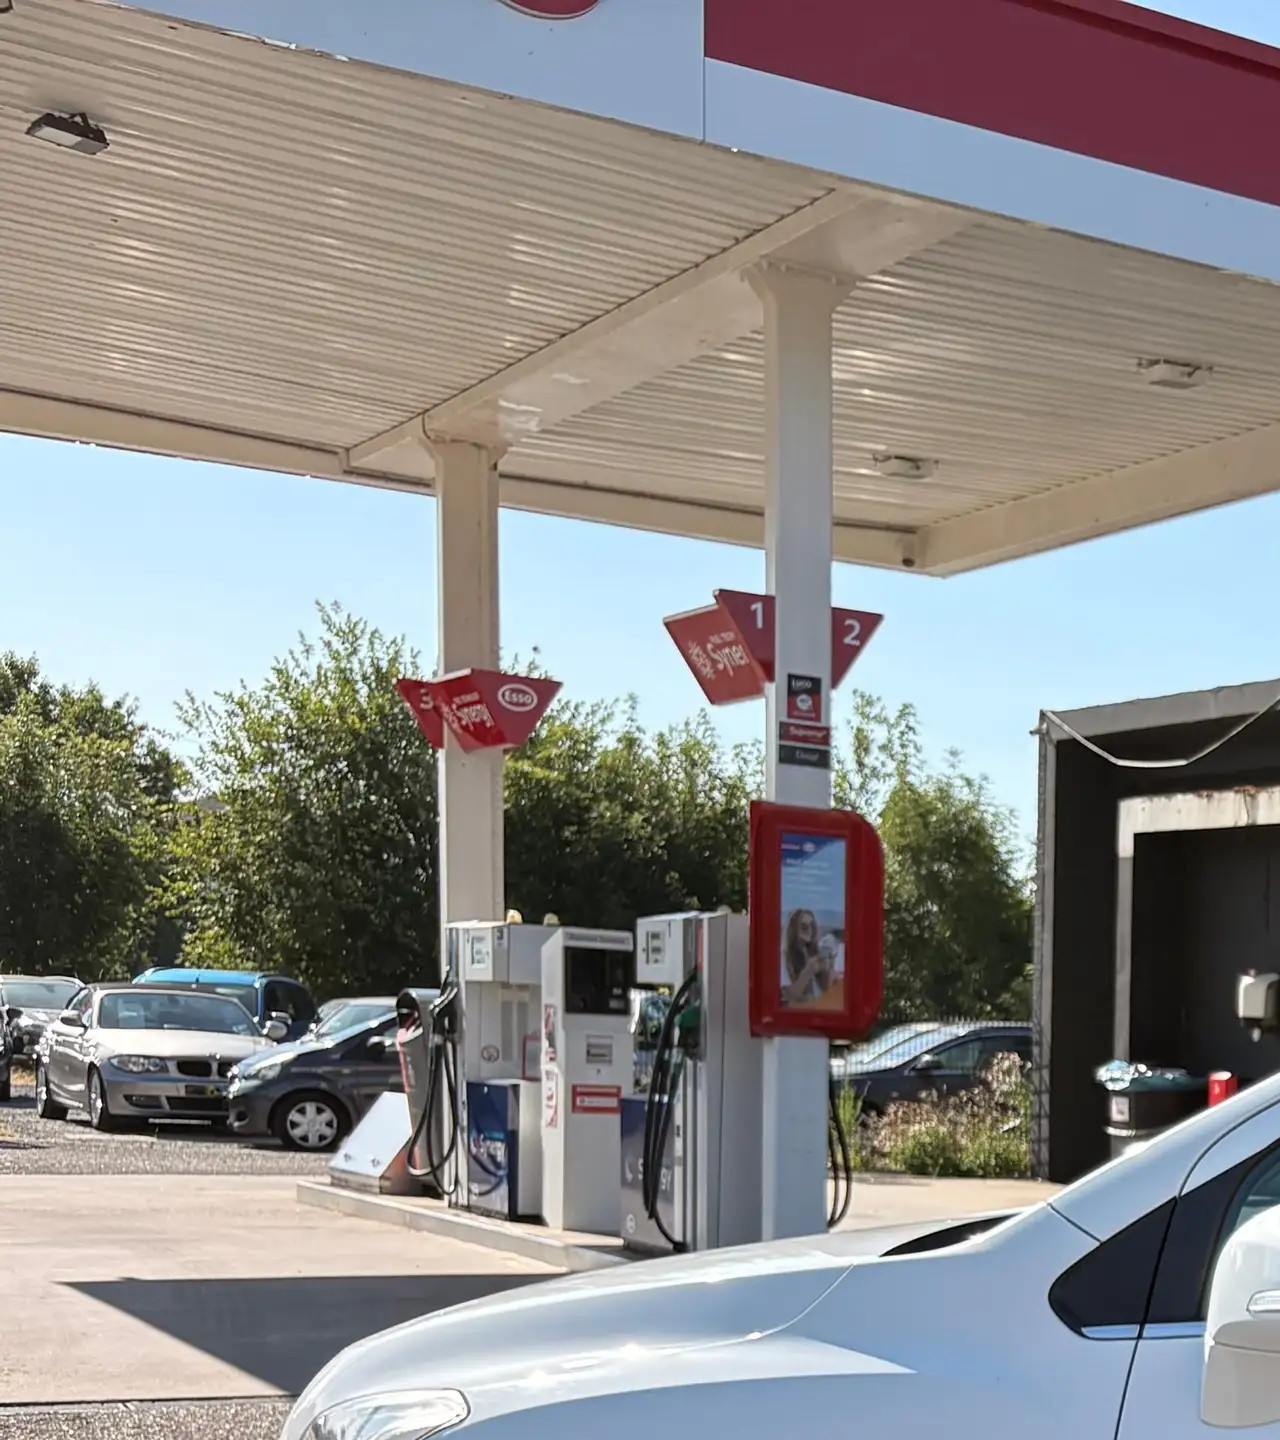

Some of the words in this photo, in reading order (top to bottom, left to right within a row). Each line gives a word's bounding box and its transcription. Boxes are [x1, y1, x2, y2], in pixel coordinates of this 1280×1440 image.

[750, 601, 764, 629] 1
[843, 619, 861, 647] 2
[503, 689, 532, 705] Esso
